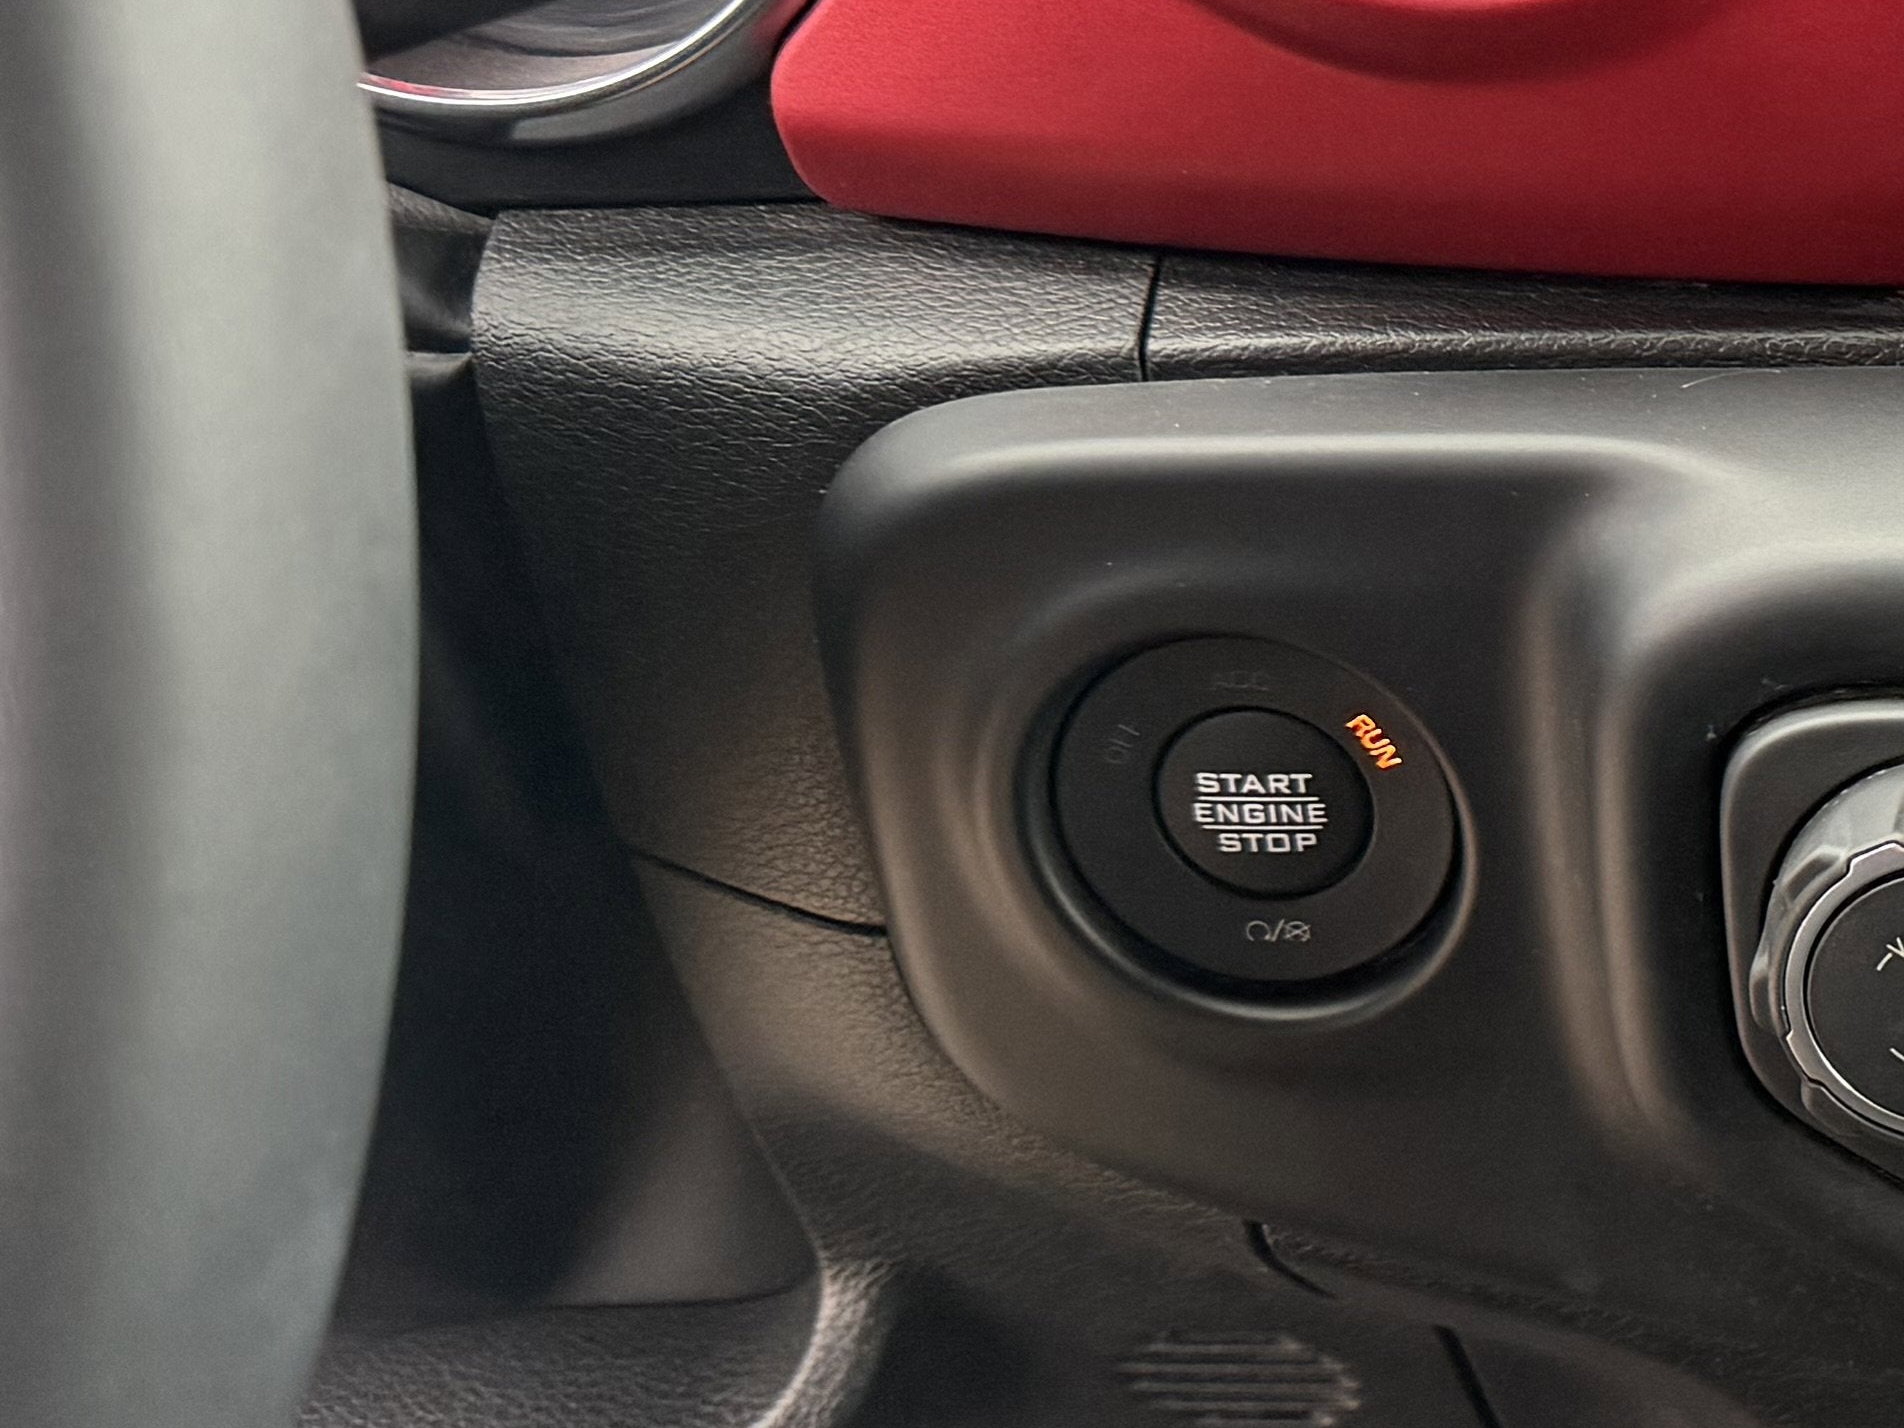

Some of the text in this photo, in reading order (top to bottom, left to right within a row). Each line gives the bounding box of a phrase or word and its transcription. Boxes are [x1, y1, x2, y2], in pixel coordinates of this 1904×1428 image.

[1344, 714, 1403, 770] RUN
[1195, 772, 1313, 795] START
[1193, 802, 1328, 824] ENGINE
[1218, 833, 1317, 853] STOP
